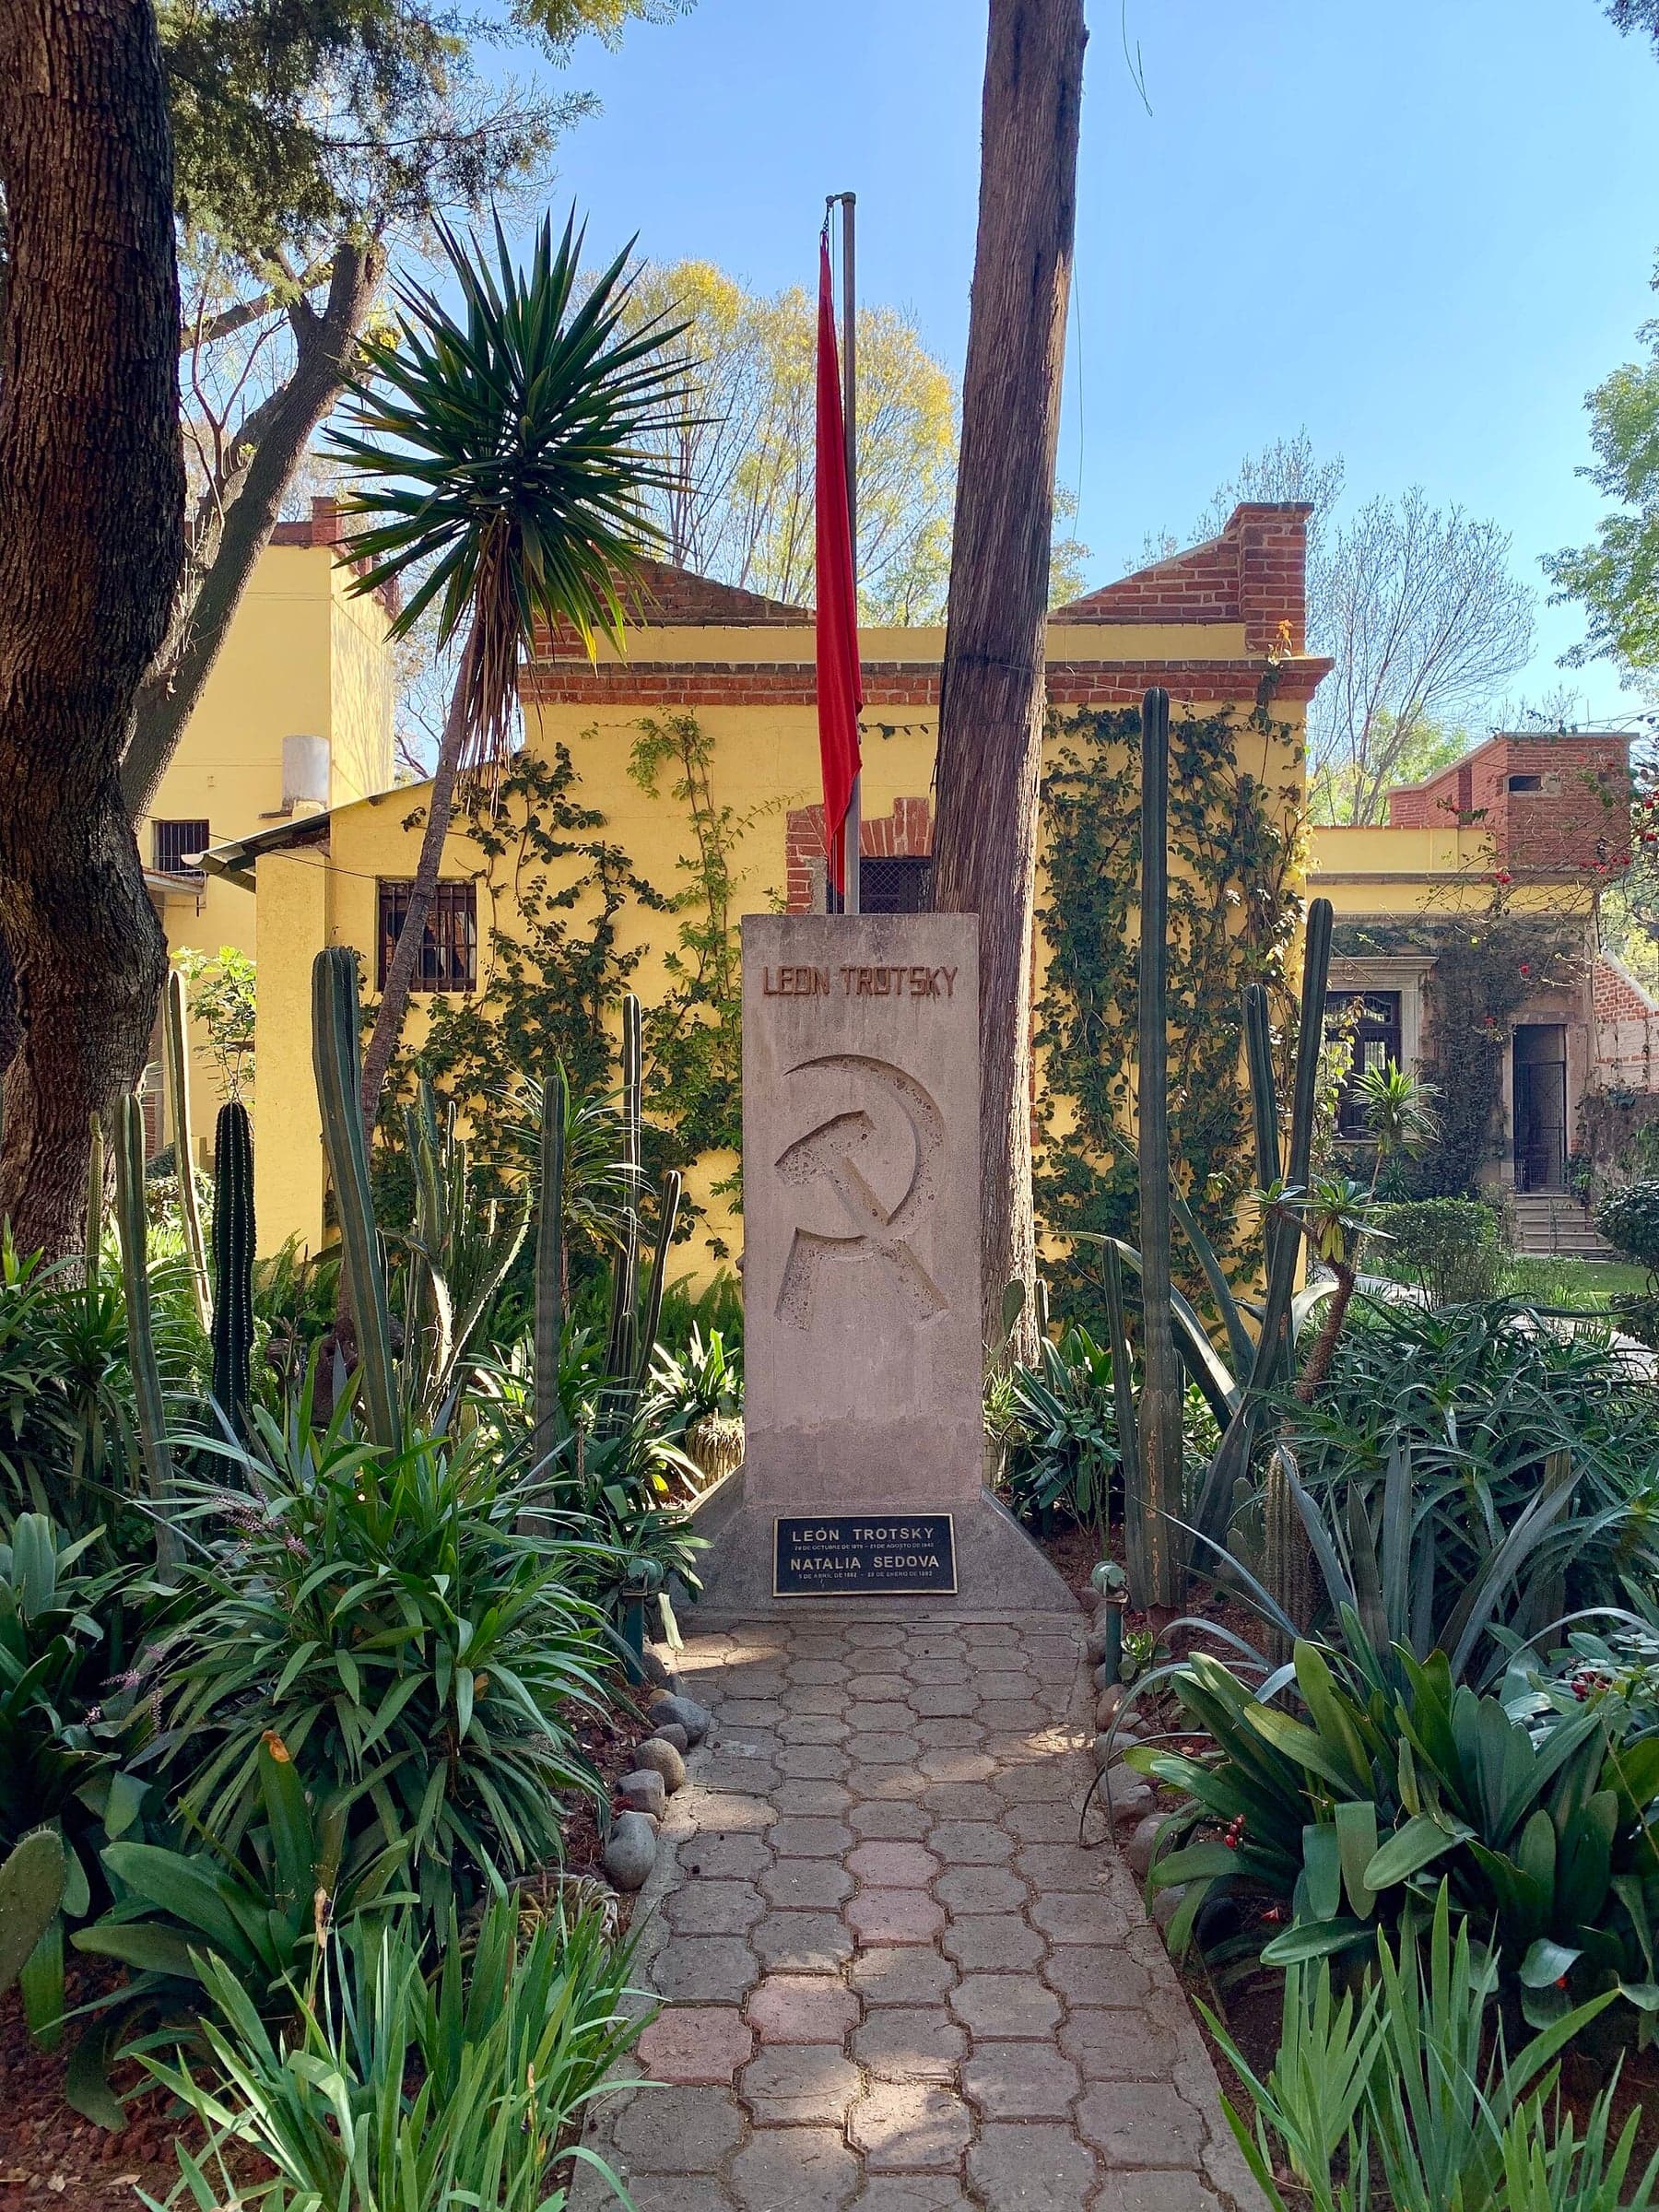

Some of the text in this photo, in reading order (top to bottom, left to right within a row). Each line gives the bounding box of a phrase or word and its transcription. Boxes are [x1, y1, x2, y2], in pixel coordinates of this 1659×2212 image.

[763, 965, 959, 995] LEON TROTSKY
[793, 1527, 935, 1542] LEÓN TROTSKY
[790, 1556, 940, 1571] NATALIA SEDOVA
